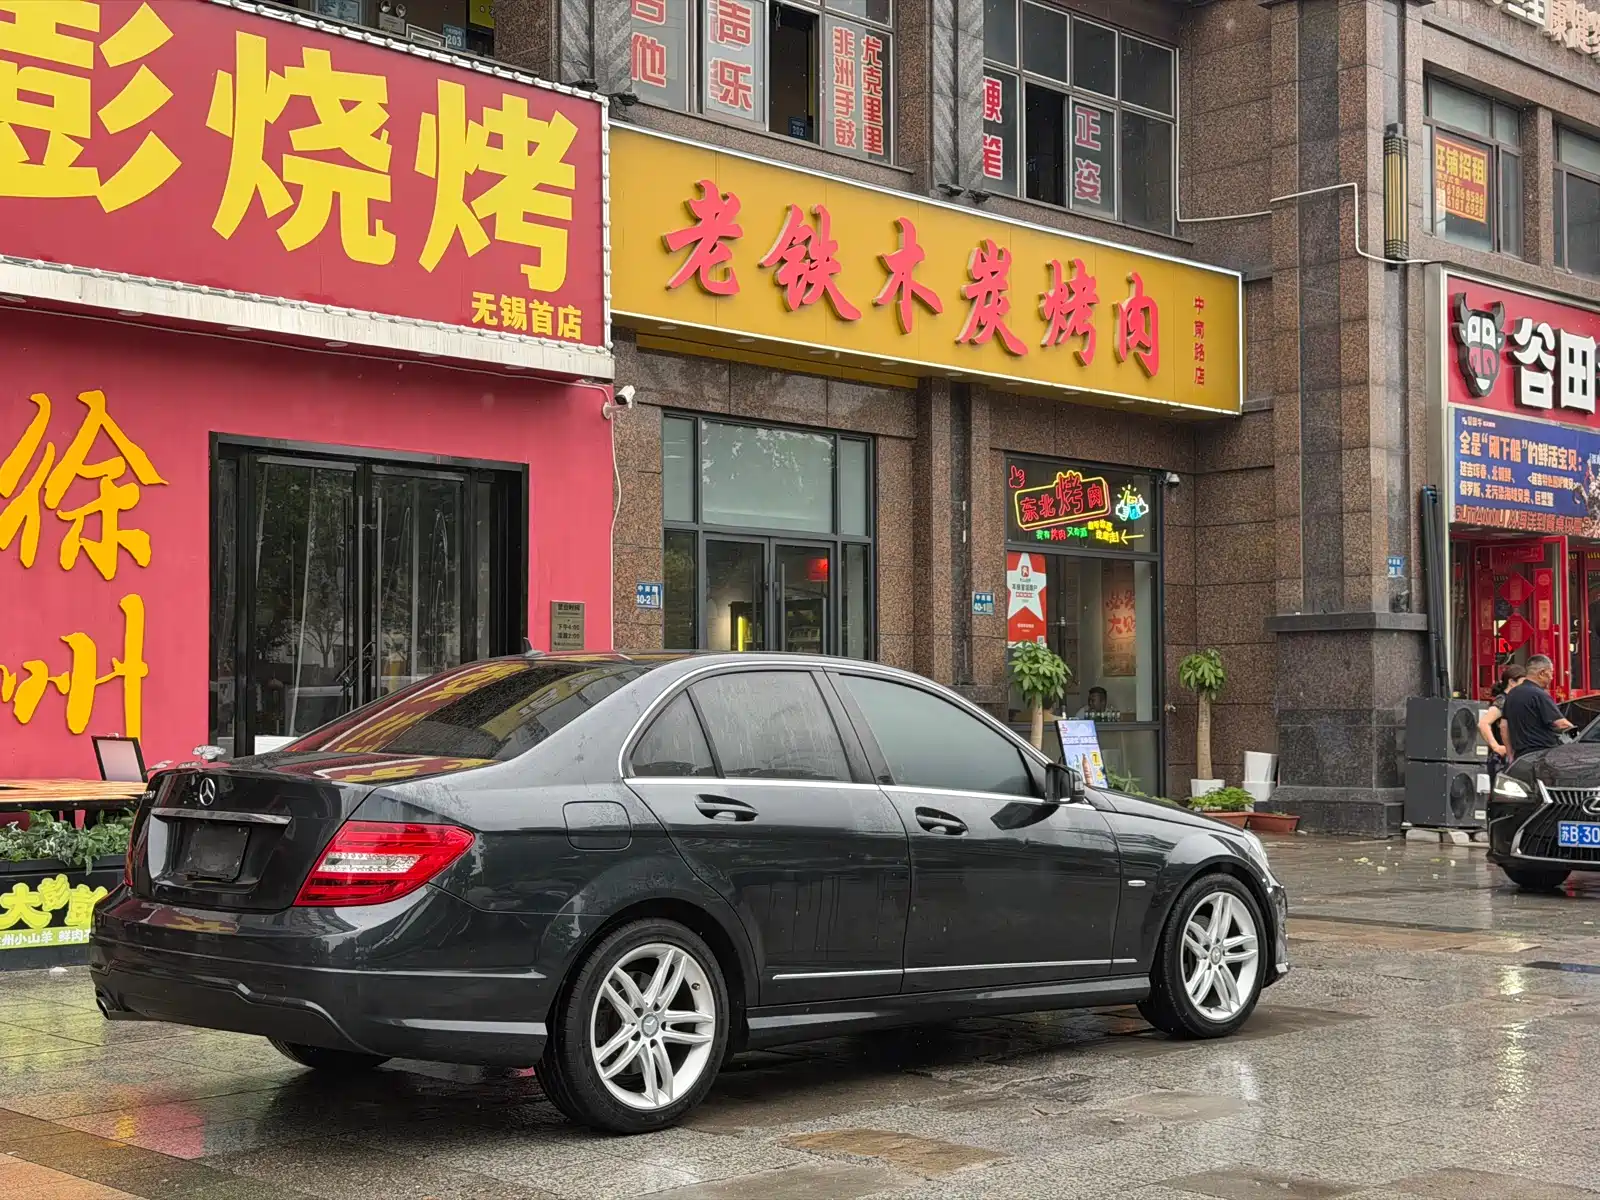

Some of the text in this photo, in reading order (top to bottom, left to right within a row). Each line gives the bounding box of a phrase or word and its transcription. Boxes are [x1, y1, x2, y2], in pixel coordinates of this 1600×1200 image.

[709, 0, 752, 111] 声乐
[832, 26, 856, 149] 非洲手鼓
[861, 35, 884, 156] 尤克里里
[1075, 105, 1101, 204] 正姿
[471, 291, 582, 340] 无锡首店
[661, 179, 1161, 378] 老铁木炭烤肉
[1508, 317, 1597, 414] 谷田
[1020, 473, 1103, 522] 东北烤肉
[0, 389, 169, 747] 徐州
[1561, 825, 1600, 843] 苏B·30
[0, 930, 54, 947] 州小山羊
